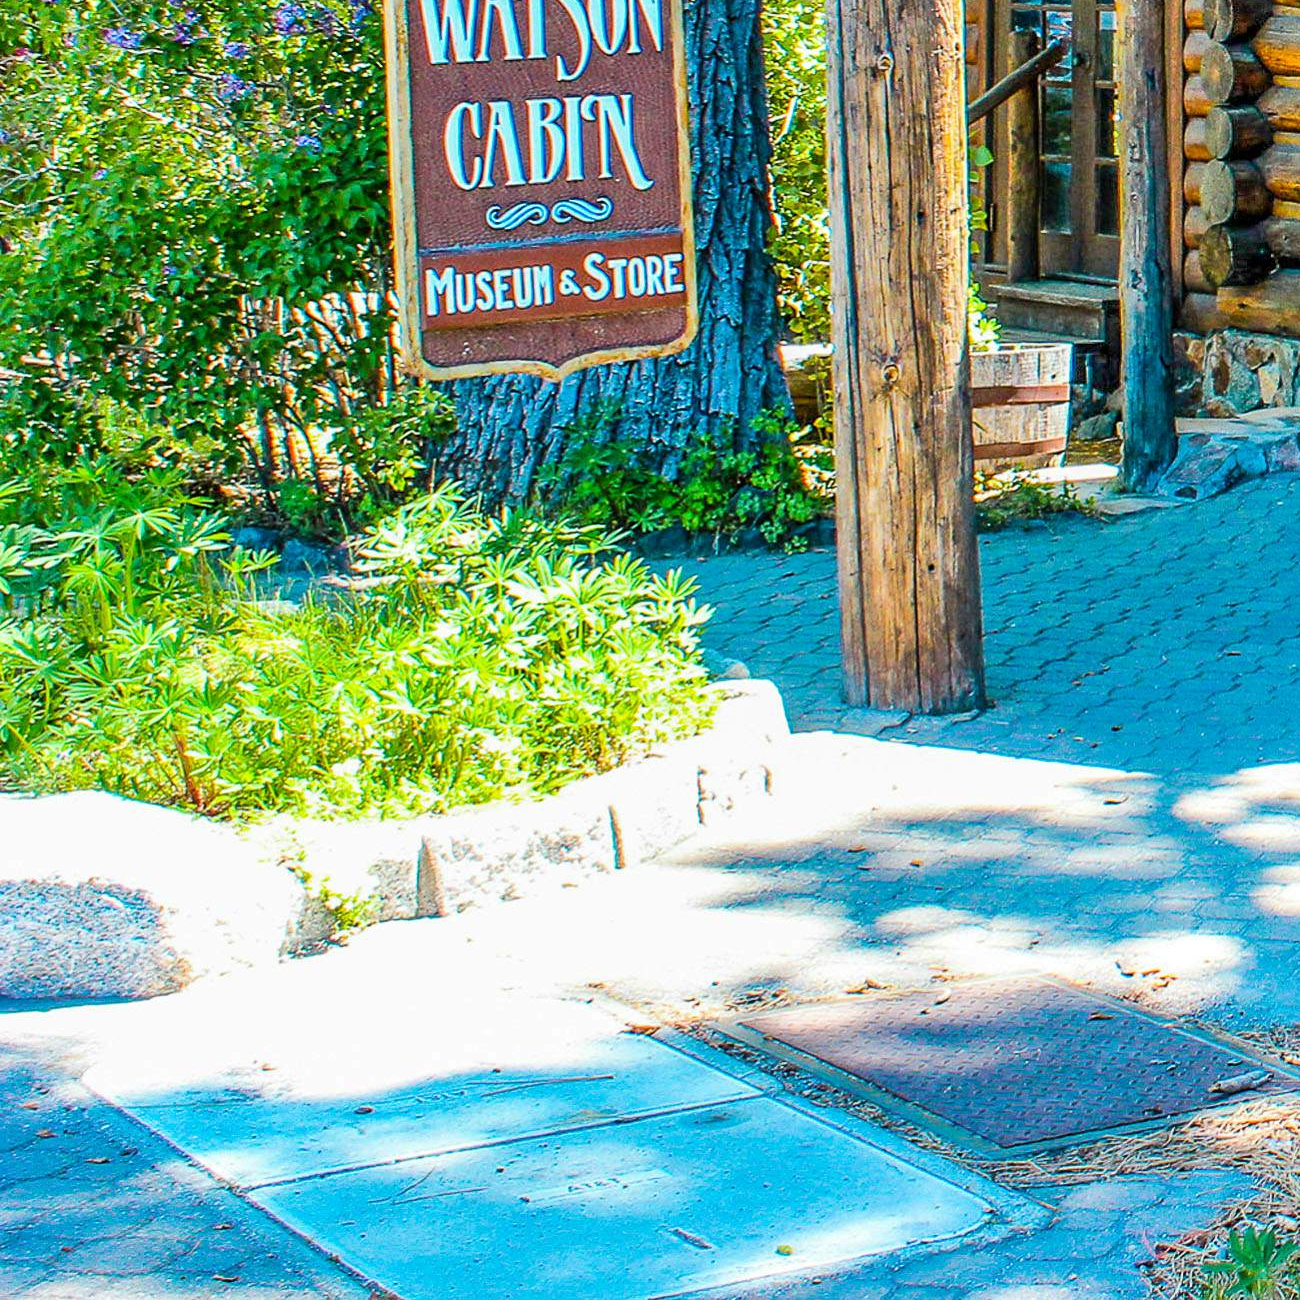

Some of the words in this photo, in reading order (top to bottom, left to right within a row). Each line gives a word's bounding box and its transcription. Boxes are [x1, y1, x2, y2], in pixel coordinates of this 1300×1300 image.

[444, 94, 656, 191] CABIN
[425, 264, 554, 317] MUSEUM
[558, 270, 580, 295] &
[583, 252, 686, 302] STORE
